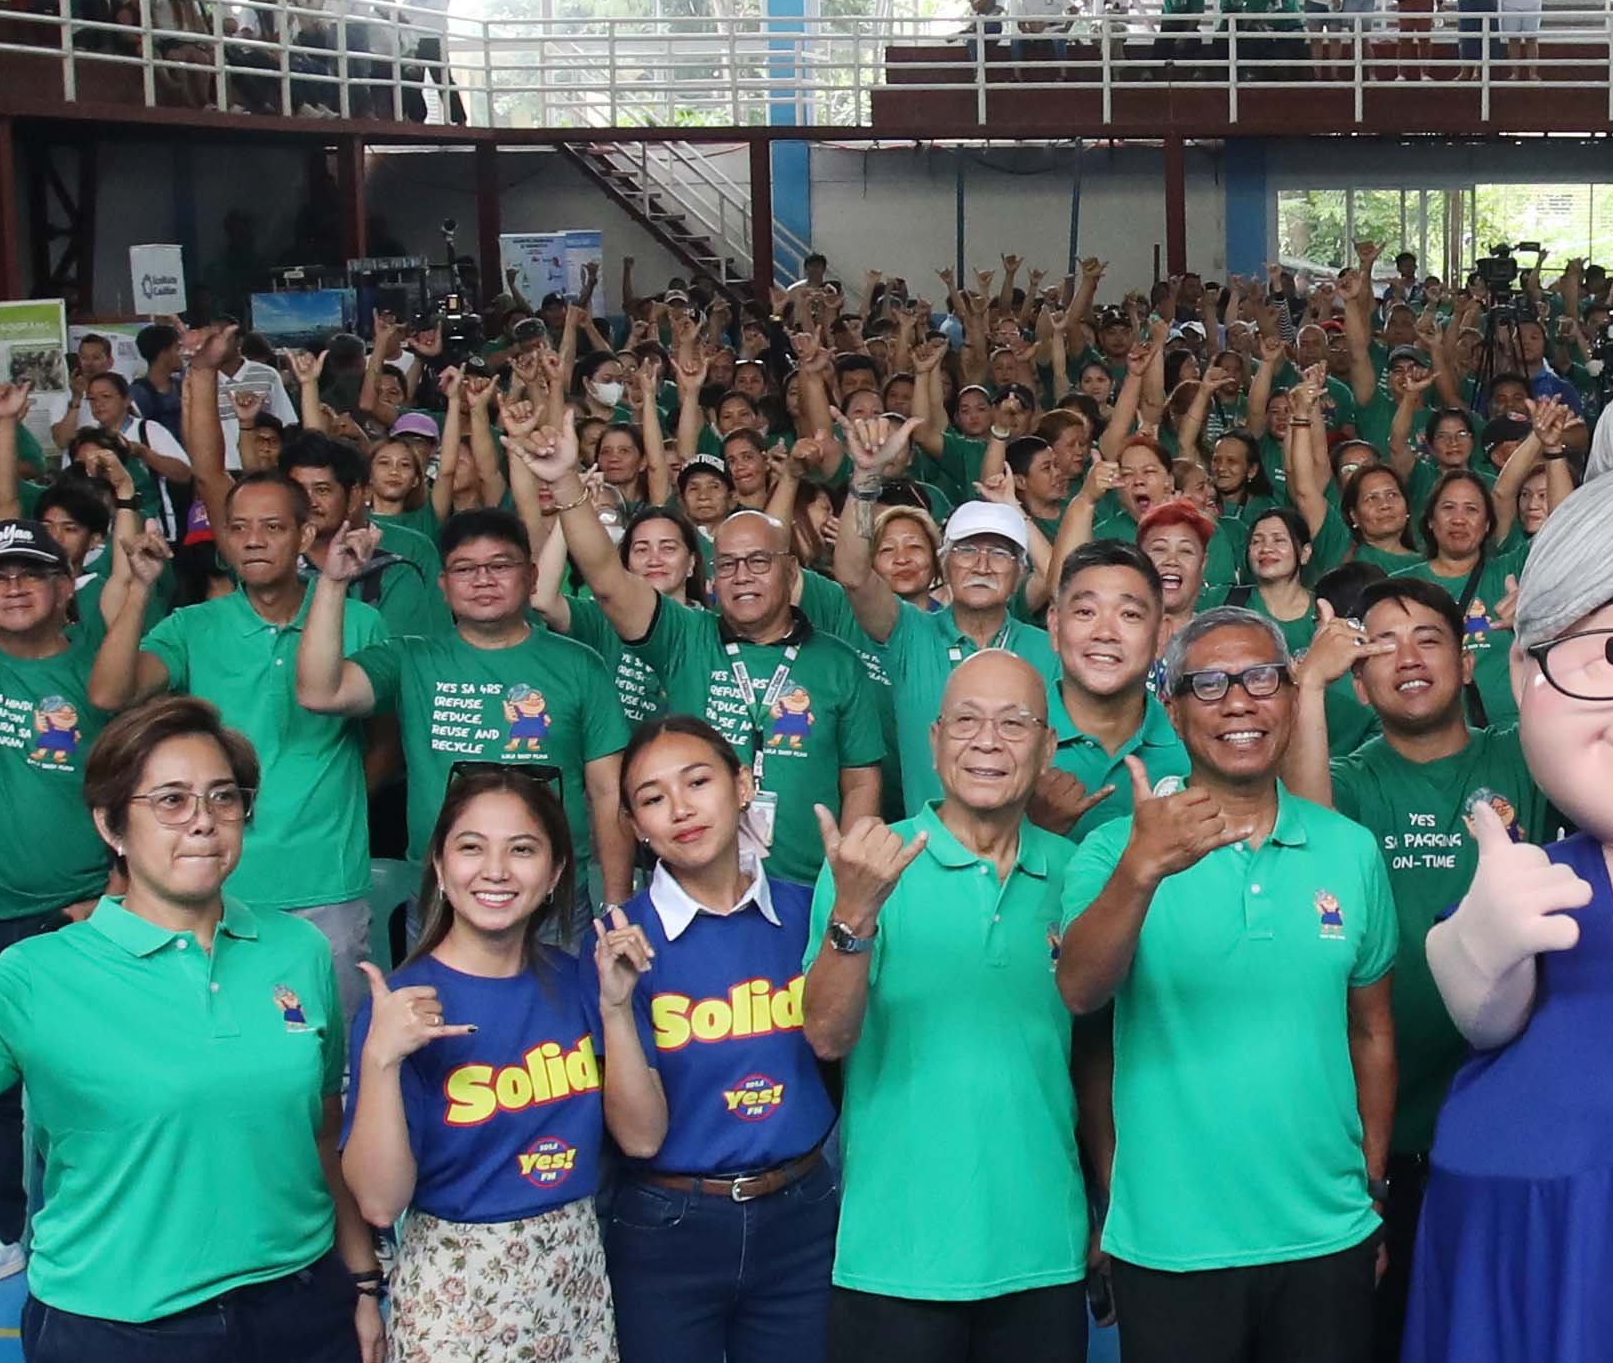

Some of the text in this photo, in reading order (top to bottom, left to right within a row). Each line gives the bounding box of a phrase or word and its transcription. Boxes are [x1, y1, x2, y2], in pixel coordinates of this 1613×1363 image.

[436, 682, 457, 693] YES
[461, 684, 475, 694] SA
[432, 724, 499, 740] REUSE AND
[432, 739, 484, 755] RECYCLE
[1409, 813, 1435, 827] YES
[1392, 854, 1455, 869] ON-TIME
[651, 976, 806, 1050] Solid
[445, 1033, 601, 1126] Solid
[724, 1084, 784, 1111] Yes!
[519, 1149, 576, 1174] Yes!
